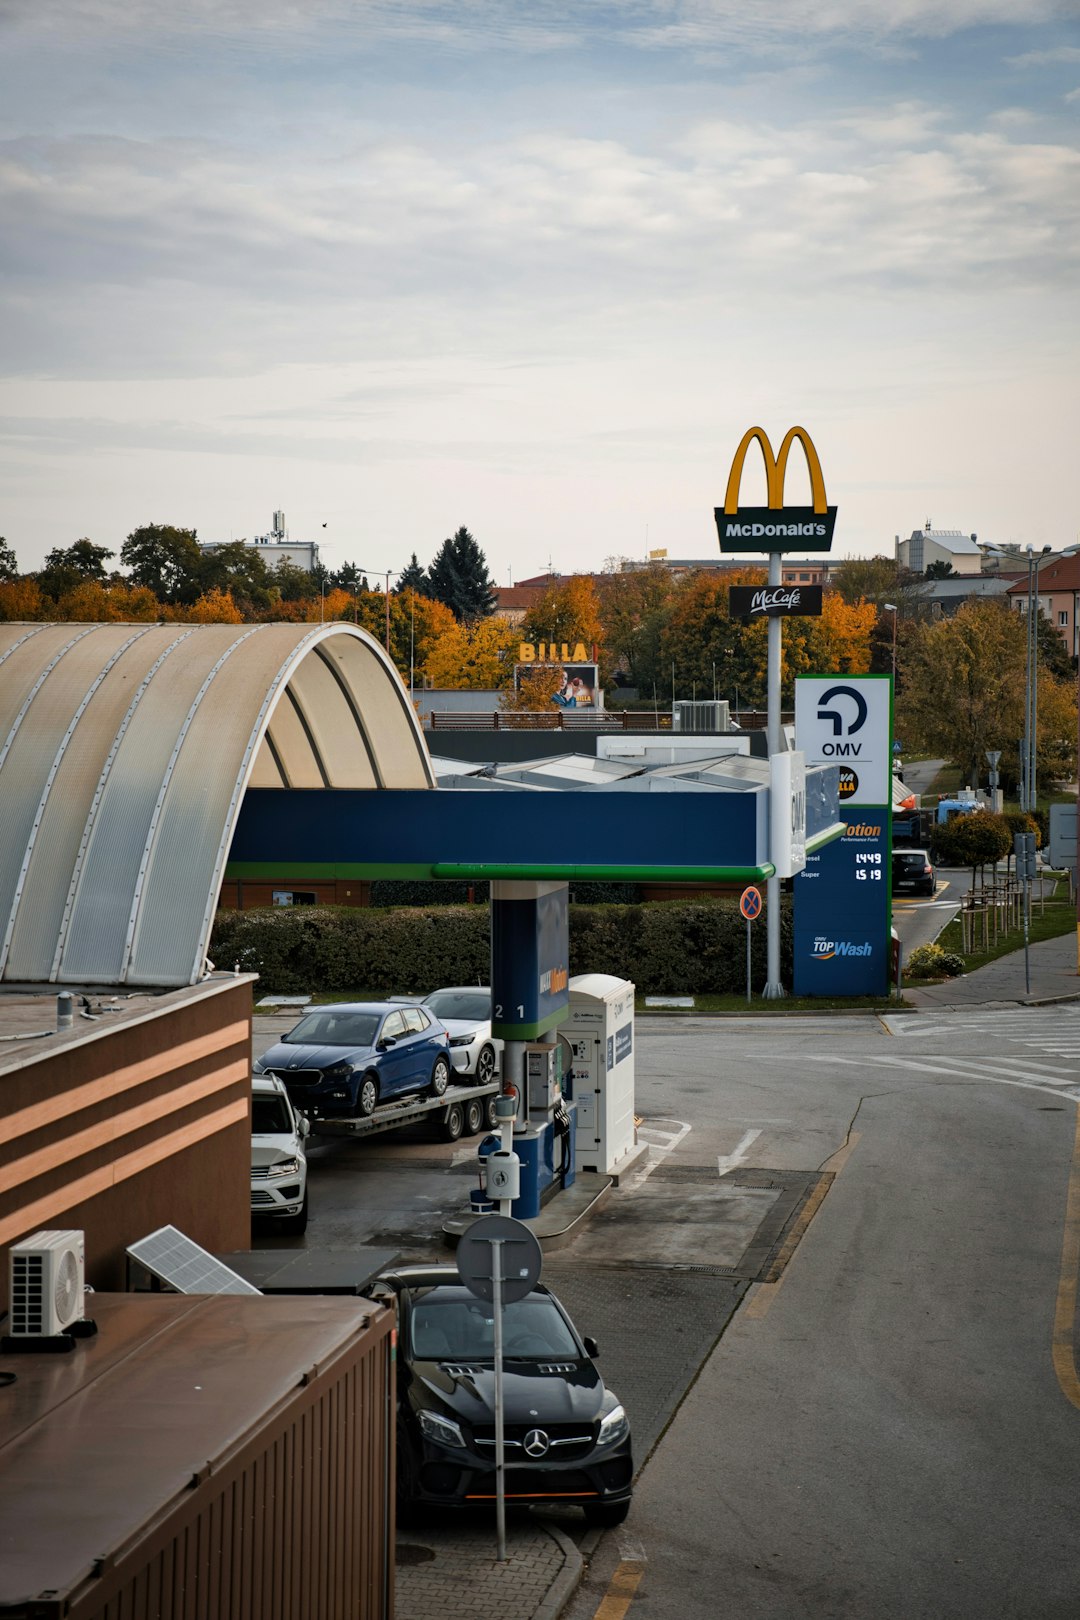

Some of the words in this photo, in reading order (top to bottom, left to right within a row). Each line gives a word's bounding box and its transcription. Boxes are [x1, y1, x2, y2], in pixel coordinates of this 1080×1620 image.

[726, 523, 826, 537] McDonald's
[750, 588, 800, 612] McCafé
[520, 643, 588, 661] BILLA
[822, 743, 862, 756] OMV
[840, 773, 855, 782] VA
[839, 783, 855, 791] LLA
[843, 822, 881, 836] otion
[800, 871, 820, 879] Super
[495, 1004, 504, 1018] 2
[516, 1004, 524, 1019] 1
